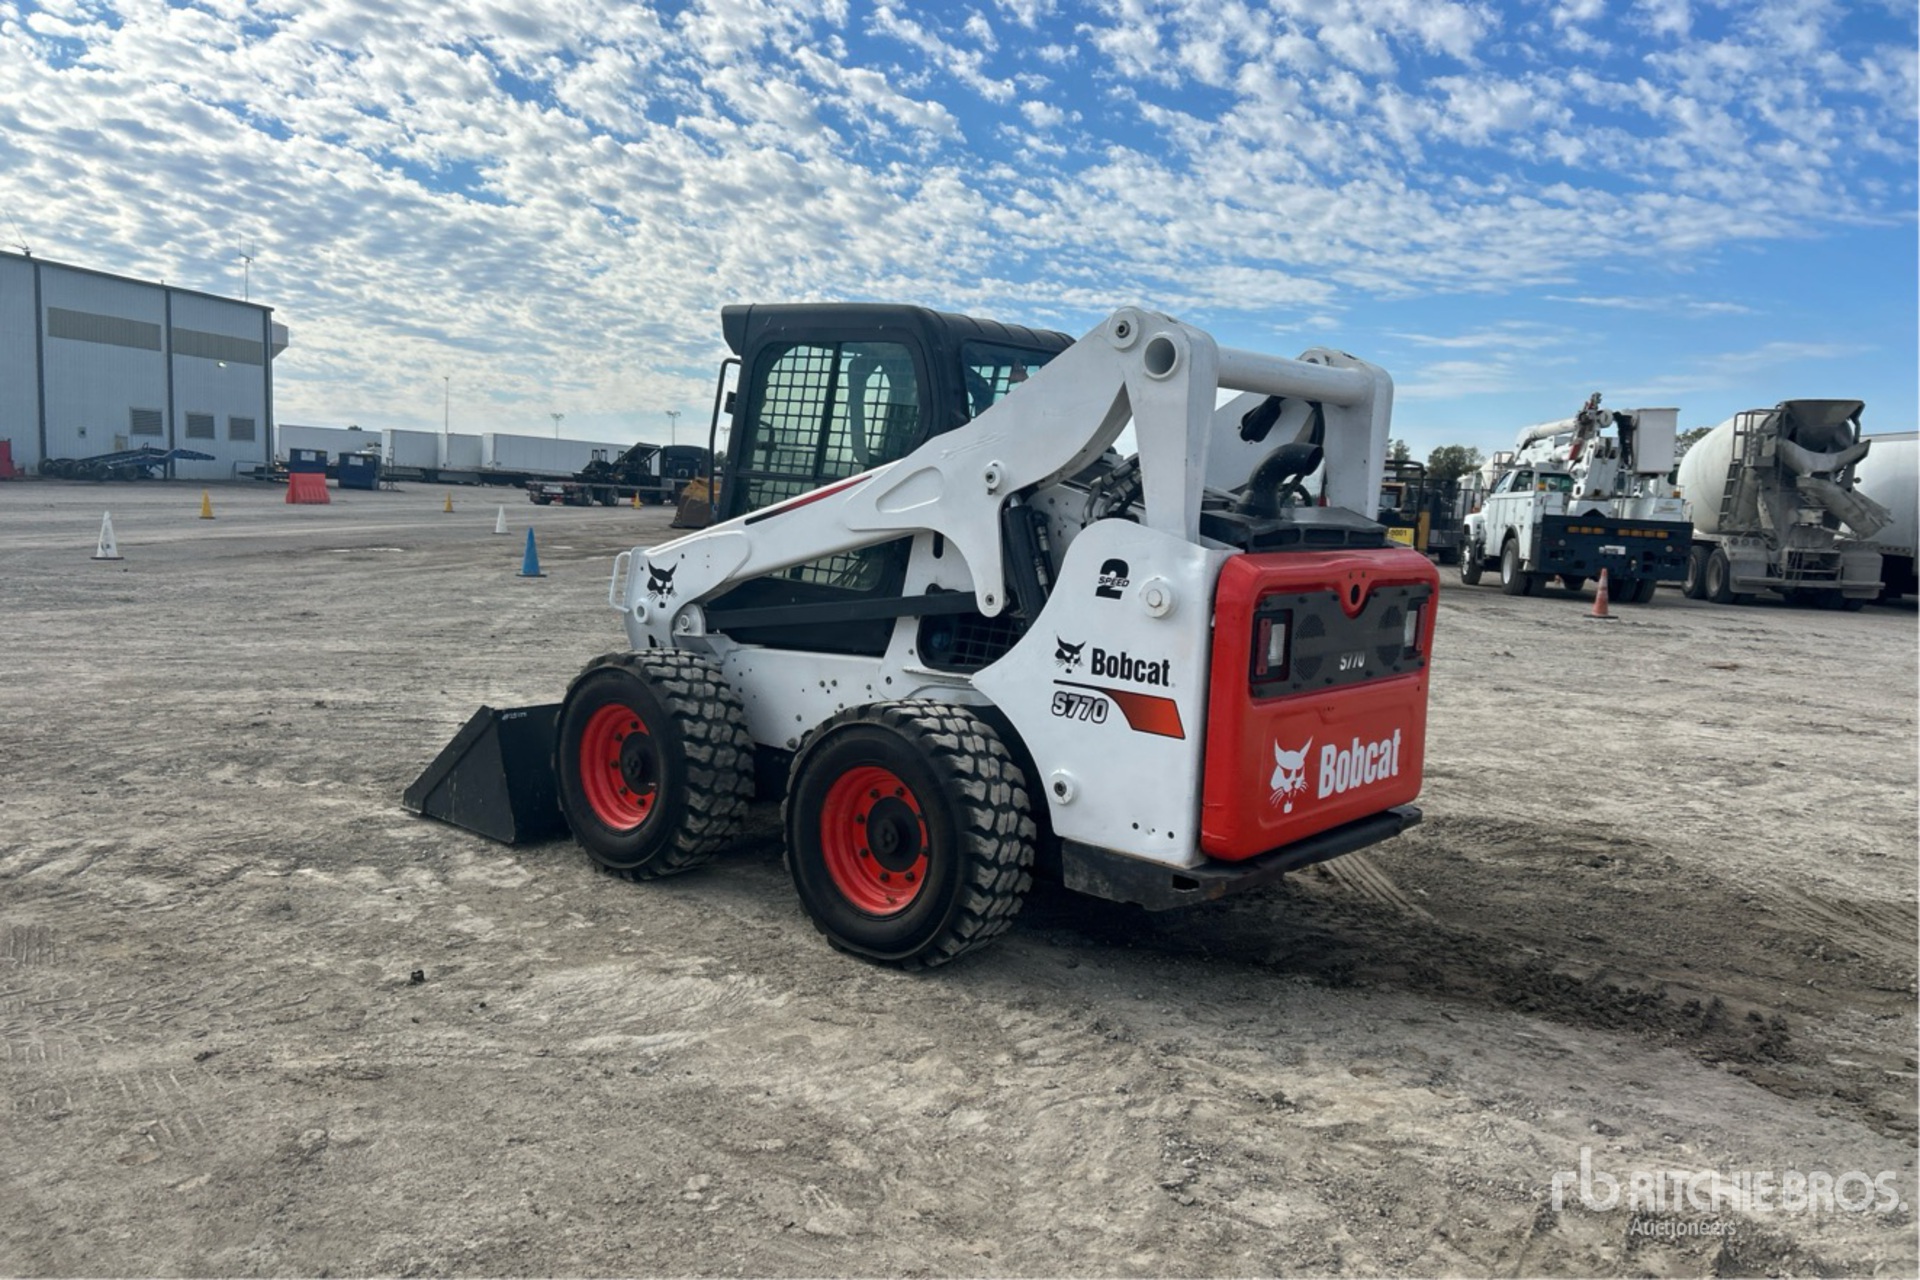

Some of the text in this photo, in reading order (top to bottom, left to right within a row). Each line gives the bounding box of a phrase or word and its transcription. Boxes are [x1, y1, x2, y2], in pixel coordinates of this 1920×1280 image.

[1095, 558, 1129, 600] 2
[1098, 576, 1130, 587] SPEED
[1091, 647, 1170, 687] Bobcat
[1051, 691, 1109, 724] S770
[1318, 728, 1401, 799] Bobcat
